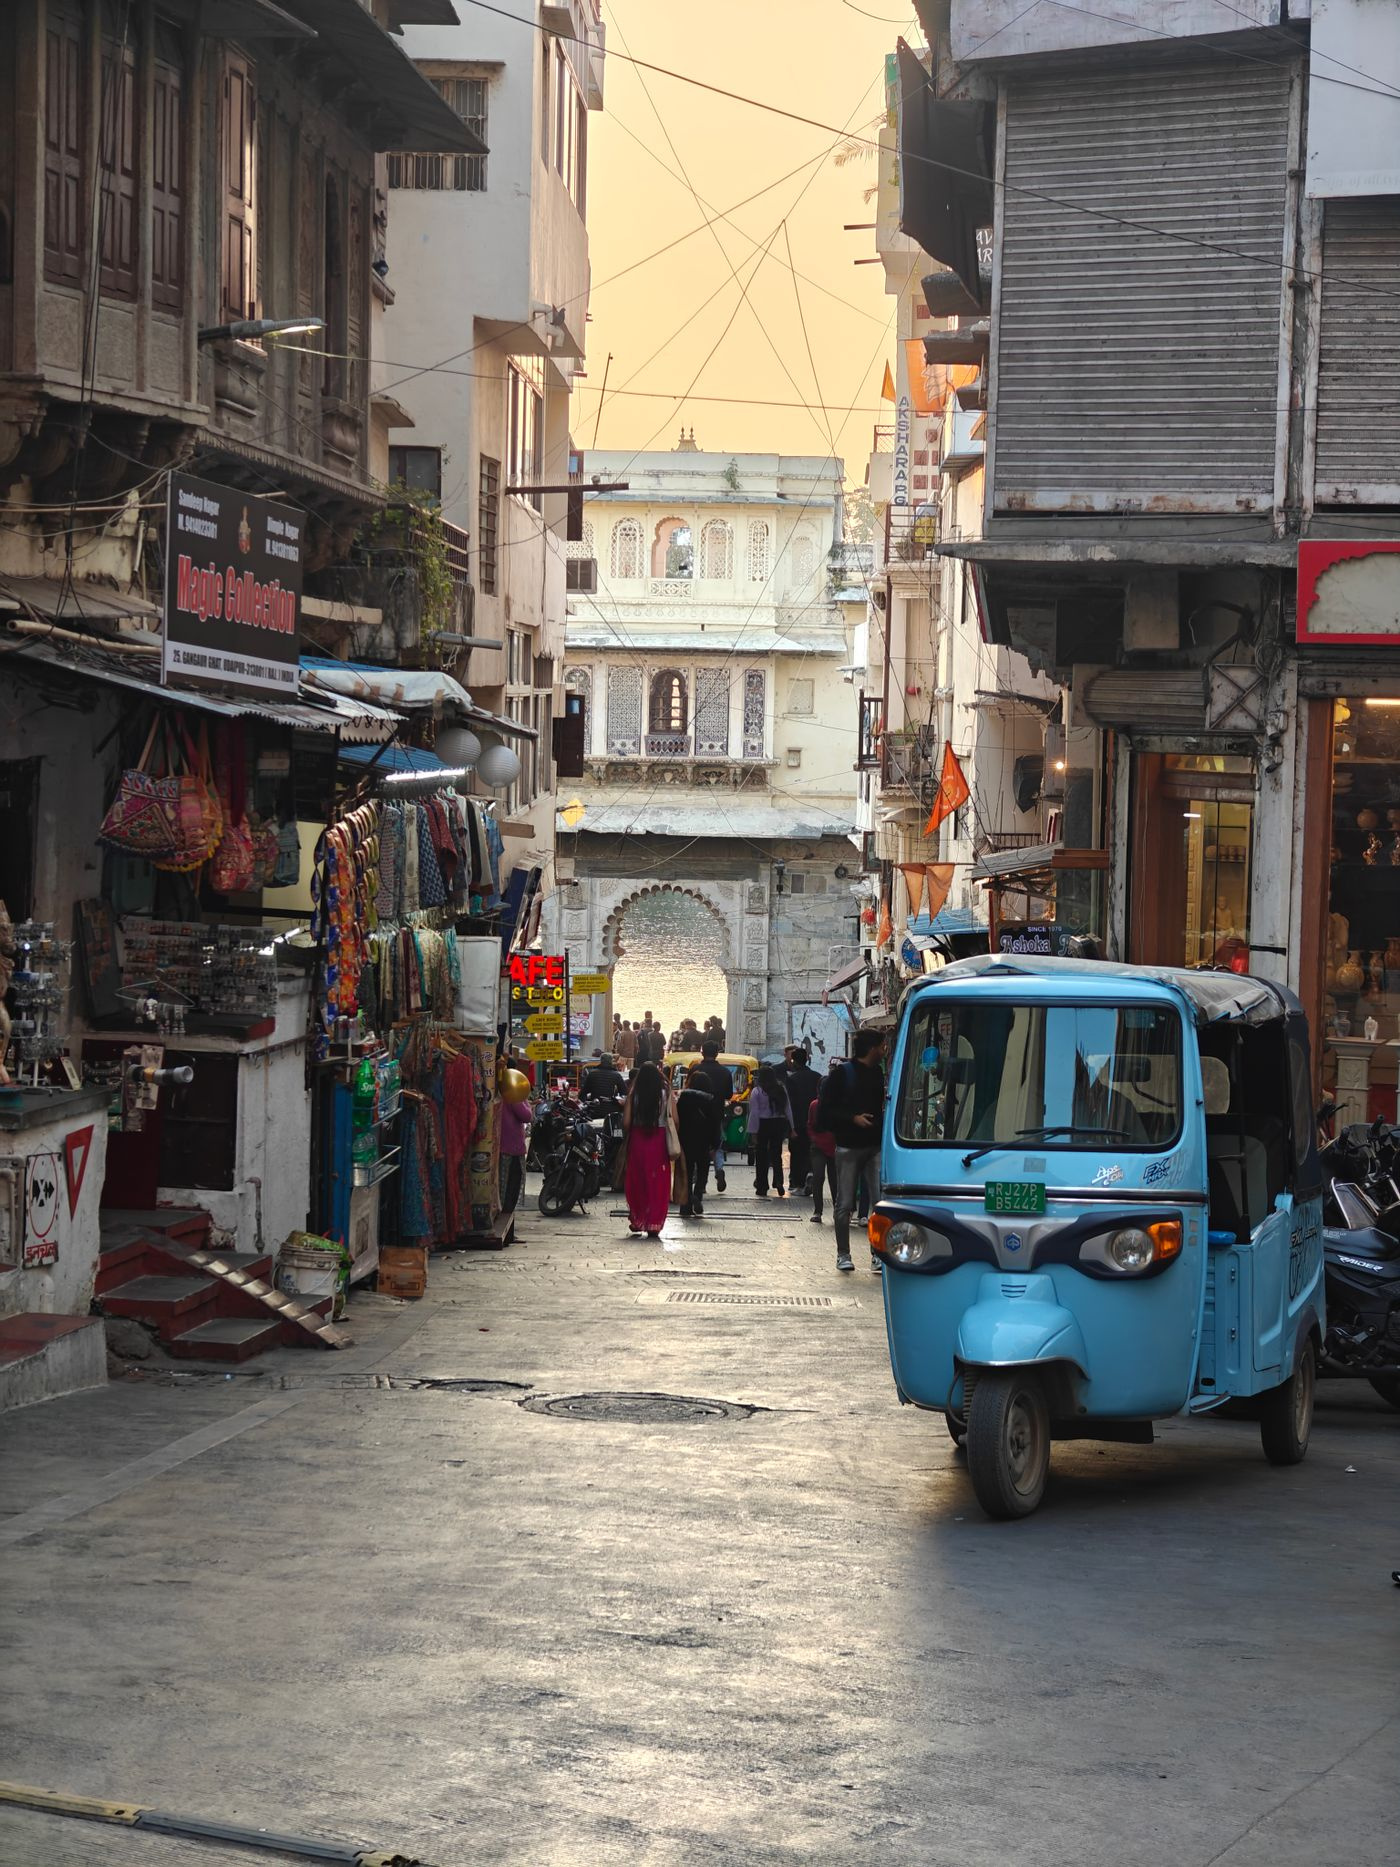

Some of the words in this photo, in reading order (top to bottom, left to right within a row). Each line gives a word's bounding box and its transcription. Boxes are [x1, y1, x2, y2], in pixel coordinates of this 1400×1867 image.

[177, 554, 223, 622] Magic
[225, 565, 296, 635] Collection
[182, 652, 207, 668] GANGAUR
[281, 670, 294, 682] INDIA
[1000, 934, 1051, 954] Ashoka
[1143, 1157, 1170, 1179] FX
[1146, 1167, 1170, 1184] MAX
[995, 1183, 1038, 1197] RJ27P
[996, 1197, 1038, 1210] B5442
[1337, 1254, 1384, 1273] RAIDER
